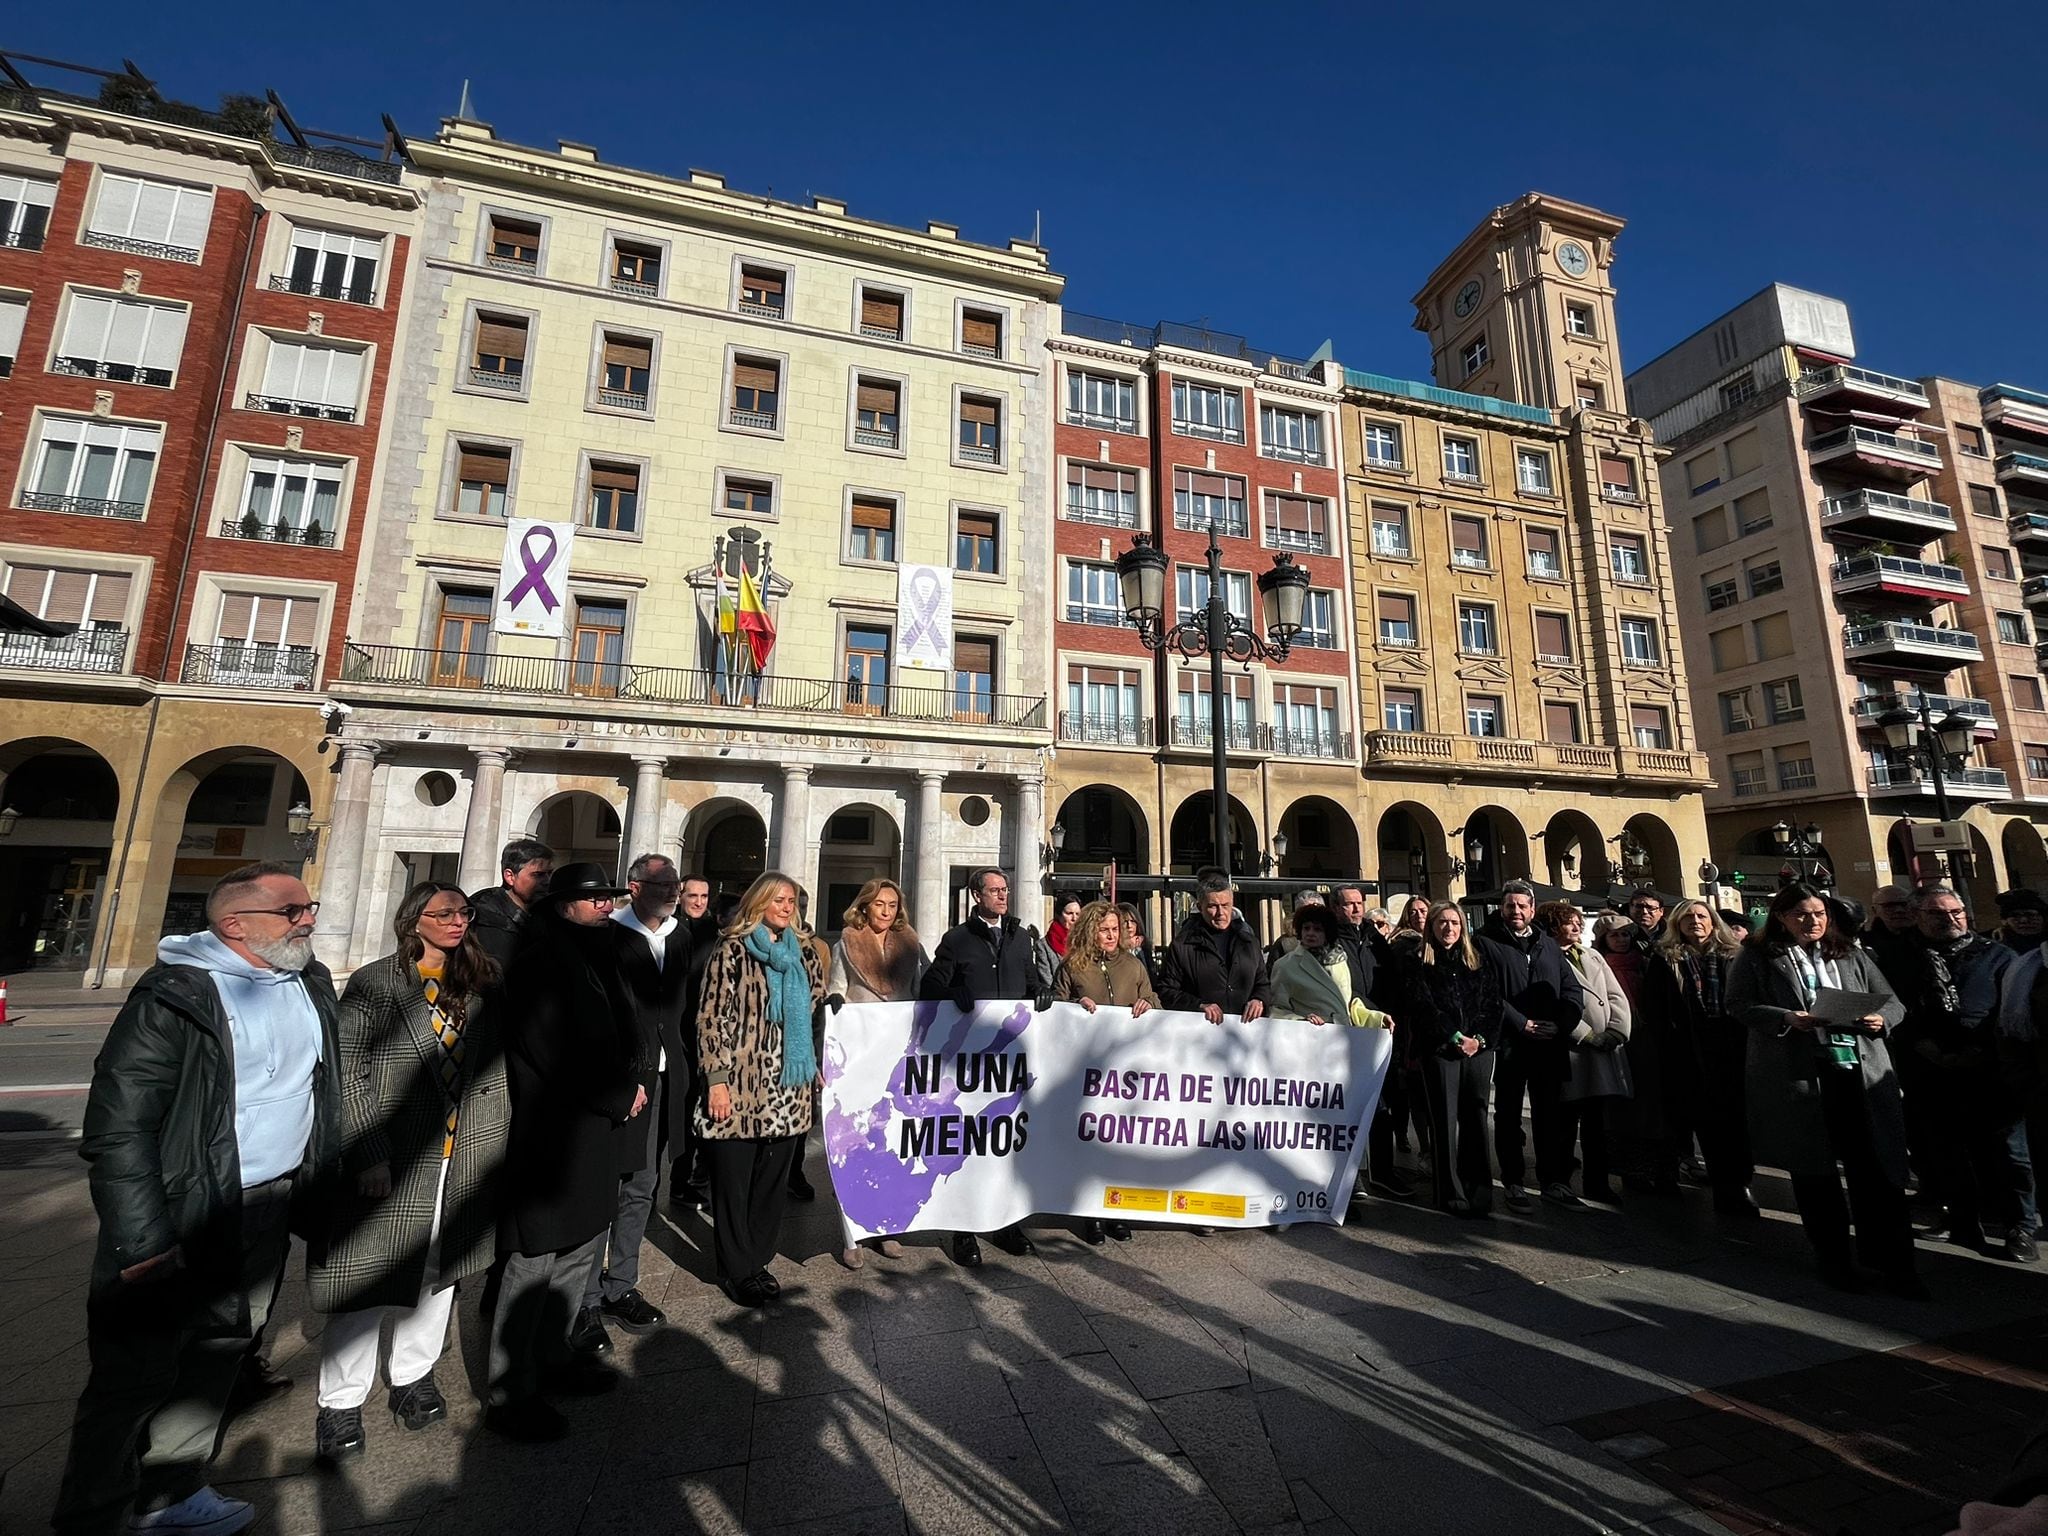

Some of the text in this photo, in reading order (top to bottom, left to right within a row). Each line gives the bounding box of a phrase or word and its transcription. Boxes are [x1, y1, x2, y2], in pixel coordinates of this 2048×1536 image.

[557, 718, 887, 750] DELEGACION DEL GOBIERNO
[904, 1052, 1028, 1095] NI UNA
[1083, 1068, 1344, 1110] BASTA DE VIOLENCIA
[900, 1111, 1028, 1159] MENOS
[1078, 1112, 1359, 1152] CONTRA LAS MUJERES
[1297, 1191, 1327, 1209] 016
